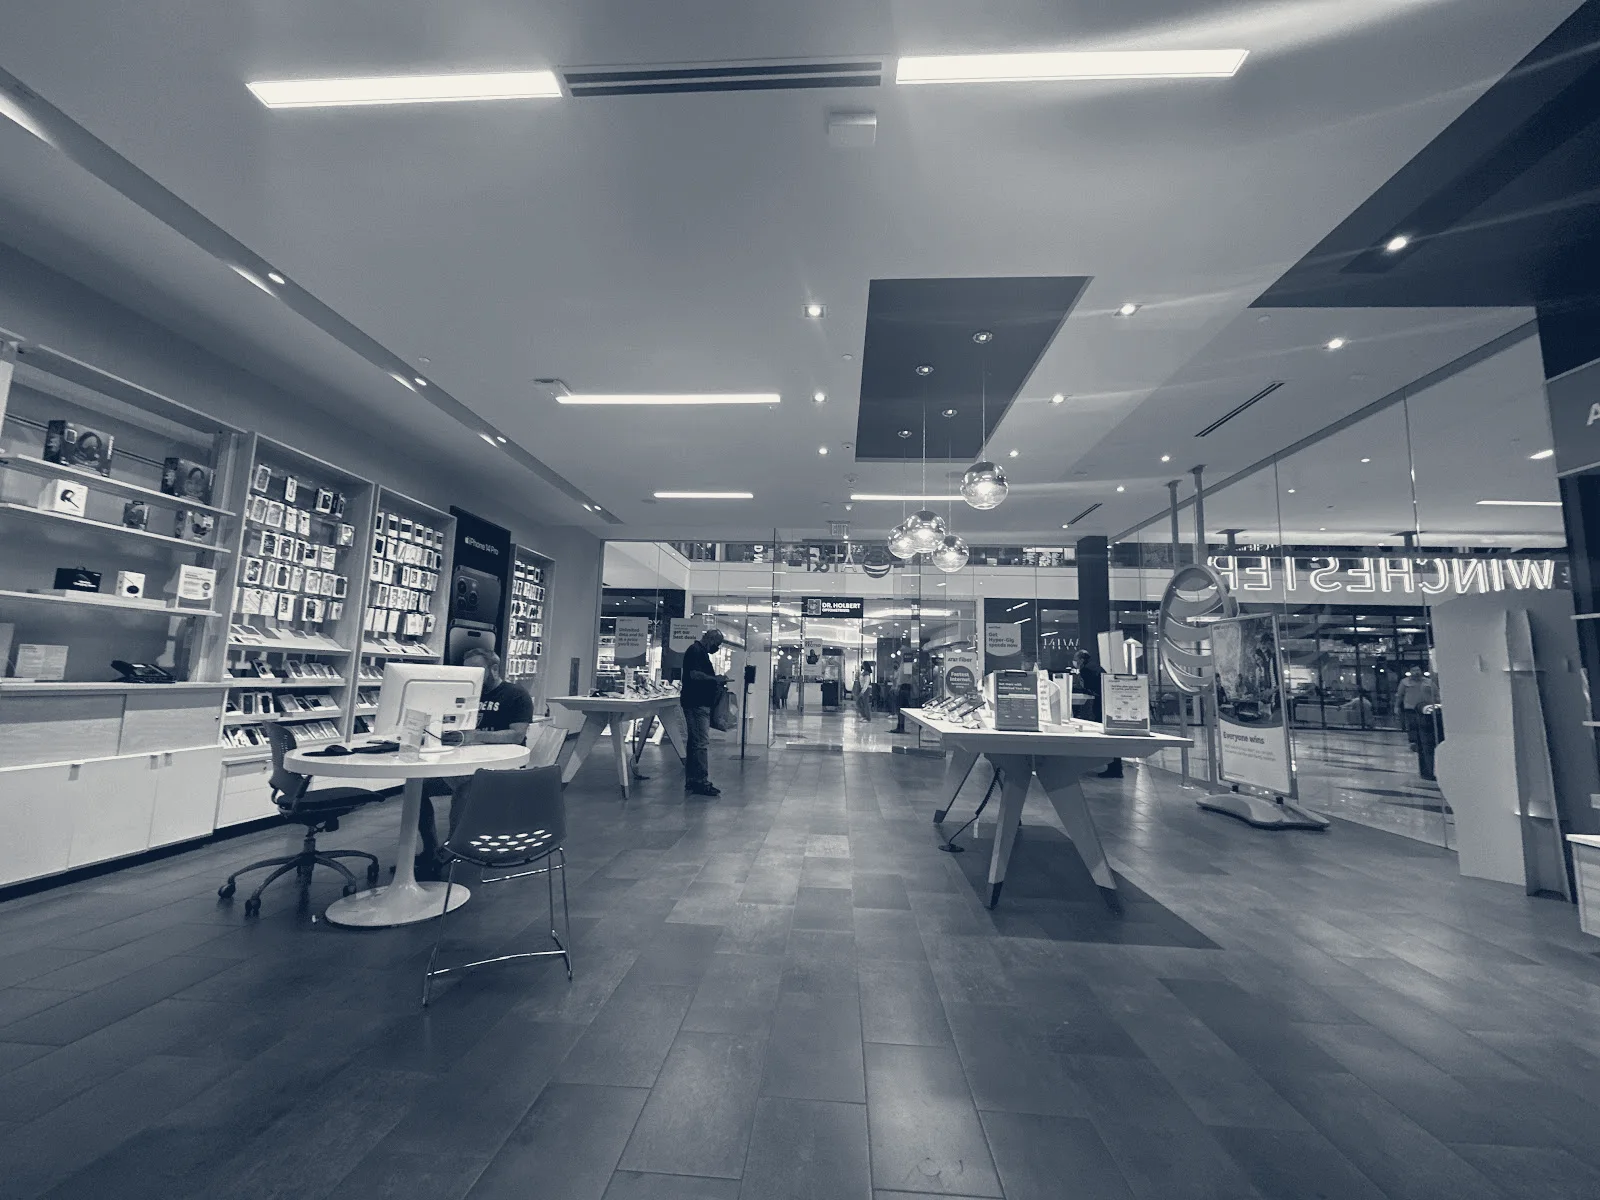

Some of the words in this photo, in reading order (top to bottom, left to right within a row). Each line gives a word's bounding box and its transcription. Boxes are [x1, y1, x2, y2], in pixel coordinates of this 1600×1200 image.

[468, 537, 486, 551] iPhone
[1222, 731, 1249, 743] Everyone
[1248, 735, 1265, 745] wins
